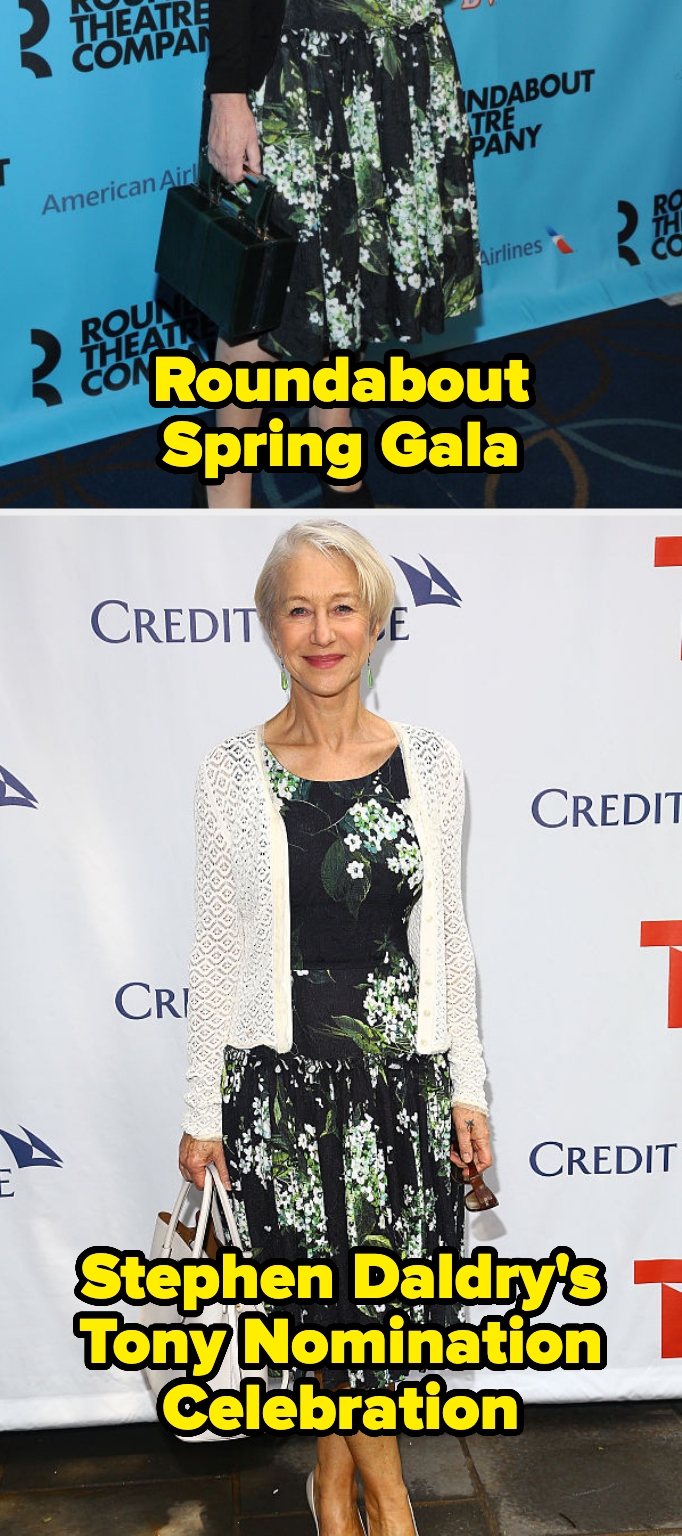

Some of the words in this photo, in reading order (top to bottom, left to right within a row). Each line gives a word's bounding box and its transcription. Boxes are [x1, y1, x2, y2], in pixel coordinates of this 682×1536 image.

[41, 176, 156, 216] American
[480, 239, 543, 267] Airlines
[91, 599, 257, 644] CREDIT
[531, 787, 682, 829] CREDIT
[529, 1141, 678, 1177] CREDIT
